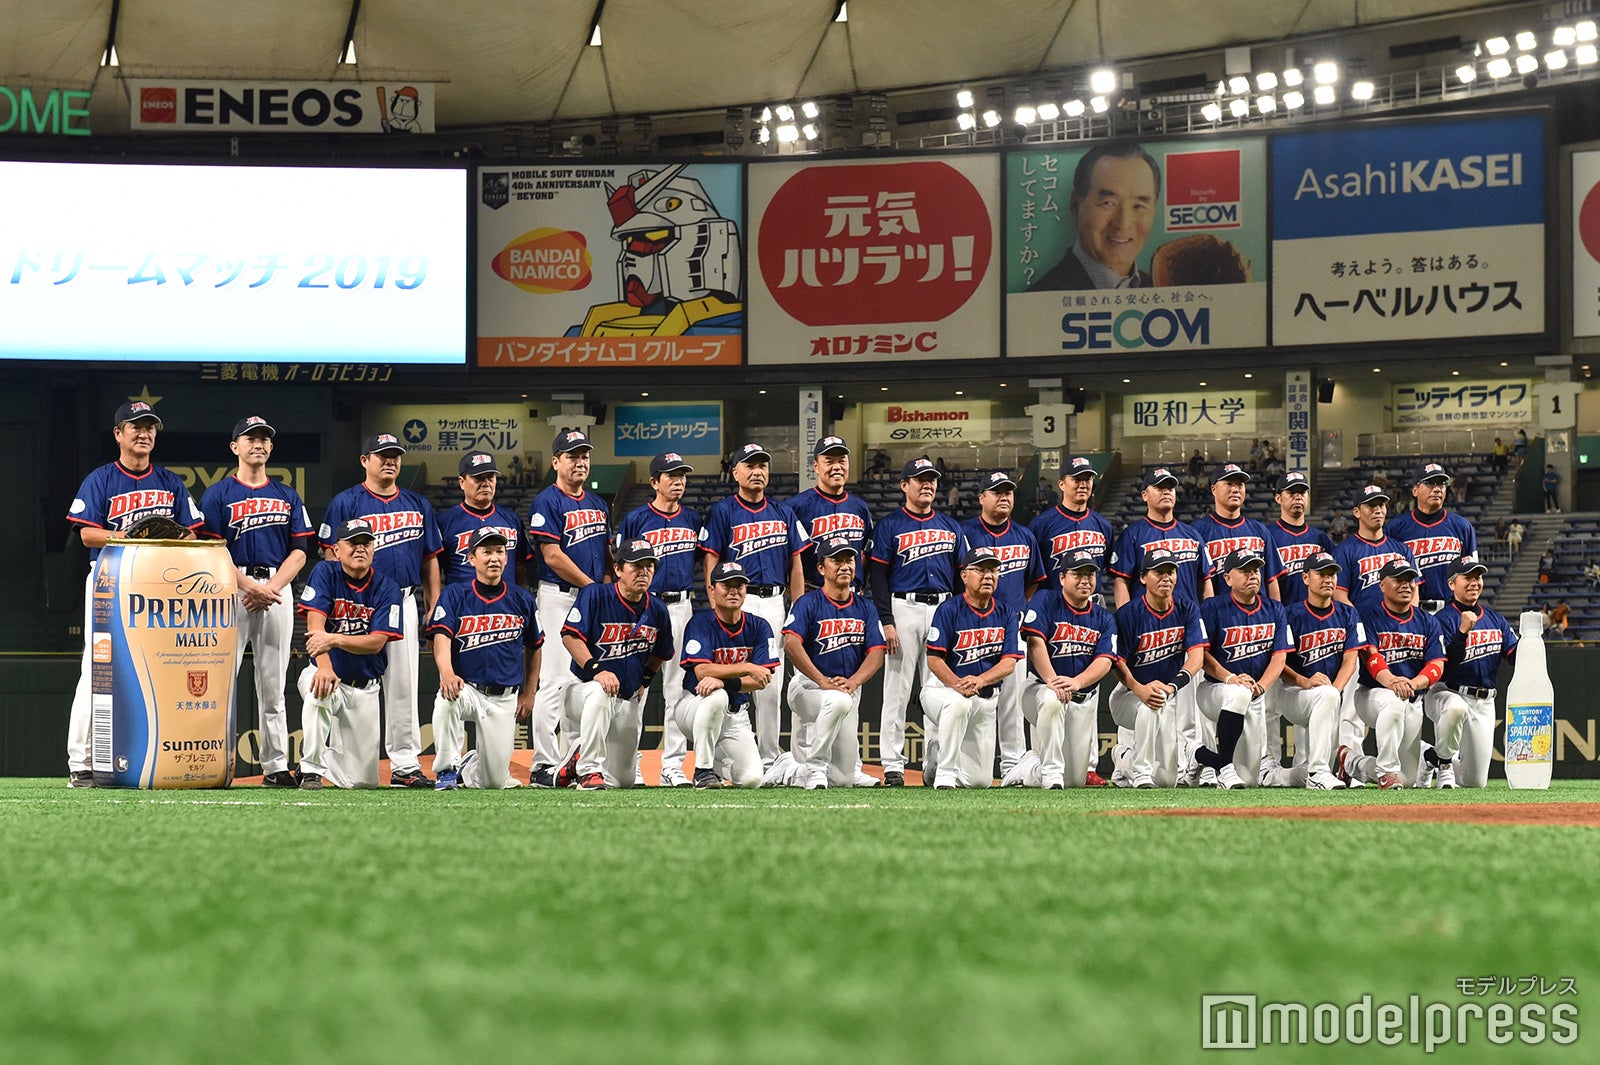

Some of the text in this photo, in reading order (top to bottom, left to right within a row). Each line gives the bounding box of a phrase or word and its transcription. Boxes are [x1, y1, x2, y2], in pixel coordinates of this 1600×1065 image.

[143, 101, 174, 110] ENEOS
[184, 88, 363, 127] ENEOS
[512, 170, 615, 179] MOBILE SUIT GUNDAM
[512, 182, 533, 190] 40th
[536, 180, 602, 189] ANNIVERSARY
[824, 191, 921, 238] 元気
[1170, 205, 1237, 225] SECOM
[510, 249, 580, 264] BANDAI
[10, 248, 428, 290] ドリームマッチ 2019
[510, 264, 581, 280] NAMCO
[1294, 281, 1522, 321] ヘーベルハウス
[1062, 308, 1210, 350] SECOM
[495, 340, 726, 363] バンダイナムコ グループ
[810, 331, 938, 356] オロナミンC
[201, 362, 279, 381] 三菱電機
[1397, 384, 1527, 410] ニッテイライフ
[1552, 395, 1562, 414] 1
[887, 406, 969, 422] Bishamon
[1134, 397, 1245, 426] 昭和大学
[437, 418, 518, 430] サッポロ生ビール
[1044, 416, 1055, 433] 3
[438, 432, 518, 451] 黒ラベル
[109, 489, 175, 519] DREAM
[230, 498, 291, 525] DREAM
[241, 514, 287, 530] Heroes
[361, 512, 424, 534] DREAM
[565, 509, 607, 532] DREAM
[811, 513, 865, 538] DREAM
[374, 529, 420, 548] Heroes
[458, 528, 517, 550] DAM
[574, 524, 606, 543] Heroe
[645, 528, 698, 547] DREAM
[731, 520, 788, 546] DREAM
[898, 530, 957, 552] DREAM
[653, 542, 695, 556] Heroes
[742, 535, 786, 555] Heroes
[908, 543, 954, 560] Heroes
[1053, 531, 1106, 555] DREAM
[992, 546, 1030, 561] REAM
[1418, 553, 1460, 567] eroes
[998, 560, 1027, 572] roes
[163, 568, 224, 595] The
[457, 614, 524, 636] DREAM
[175, 630, 218, 648] MALT'S
[466, 630, 519, 648] Heroes
[1224, 624, 1274, 647] DREA
[163, 740, 224, 752] SUNTORY
